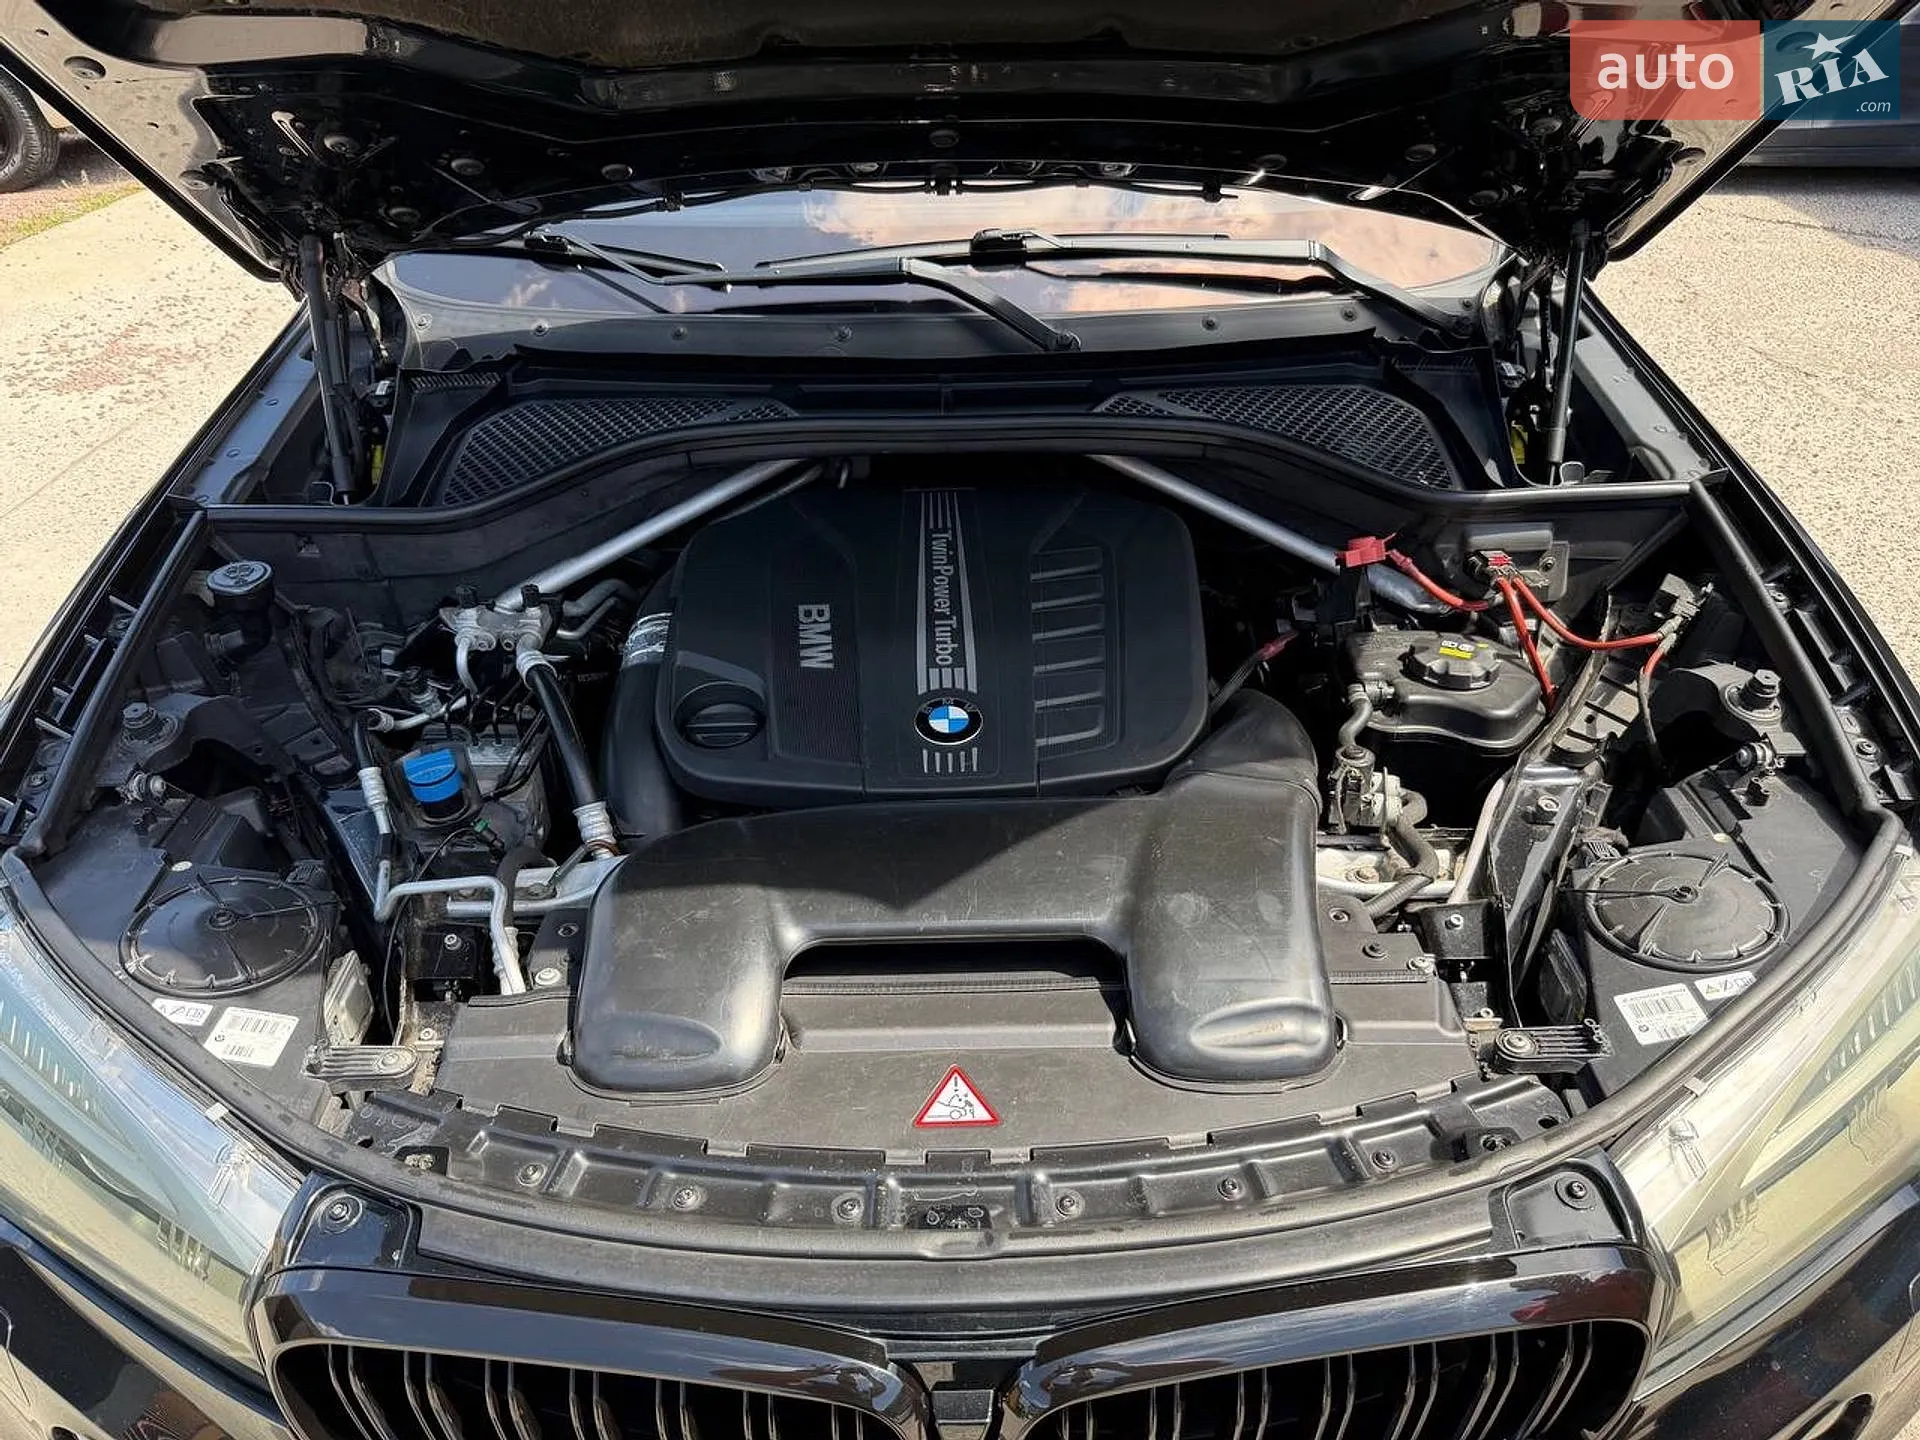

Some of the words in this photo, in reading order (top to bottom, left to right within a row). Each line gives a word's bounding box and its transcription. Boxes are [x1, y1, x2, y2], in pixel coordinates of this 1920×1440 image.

[931, 530, 954, 614] TwinPower
[798, 604, 834, 669] BMW
[934, 616, 959, 665] Turbo
